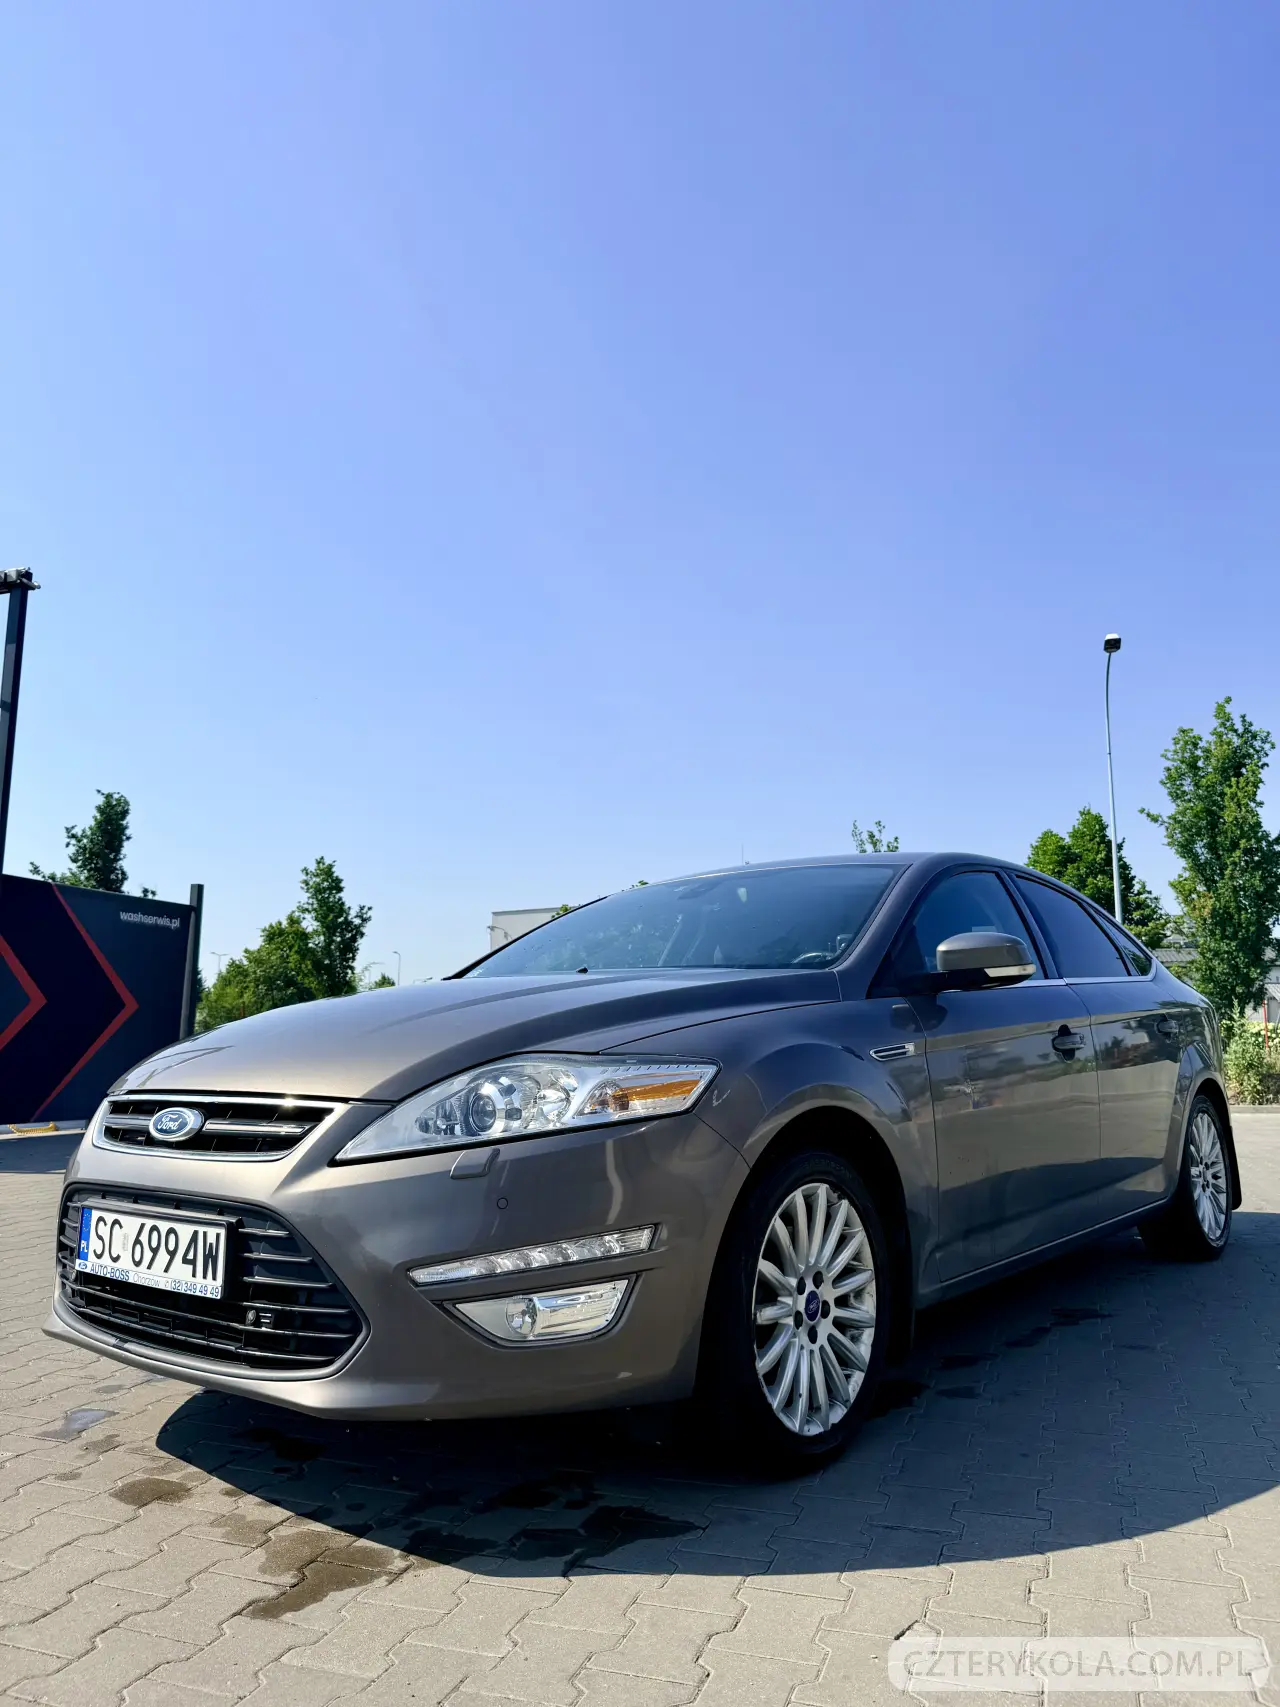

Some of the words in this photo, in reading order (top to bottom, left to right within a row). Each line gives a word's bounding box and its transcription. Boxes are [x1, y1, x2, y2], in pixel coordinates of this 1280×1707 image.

[119, 911, 180, 930] washserwis.pl
[157, 1114, 182, 1130] Ford
[80, 1240, 88, 1253] PL
[93, 1215, 123, 1263] SC
[131, 1222, 221, 1281] 6994W
[90, 1263, 130, 1281] AUTO-BOSS
[184, 1282, 197, 1294] 349
[199, 1284, 208, 1296] 49
[210, 1286, 220, 1298] 49
